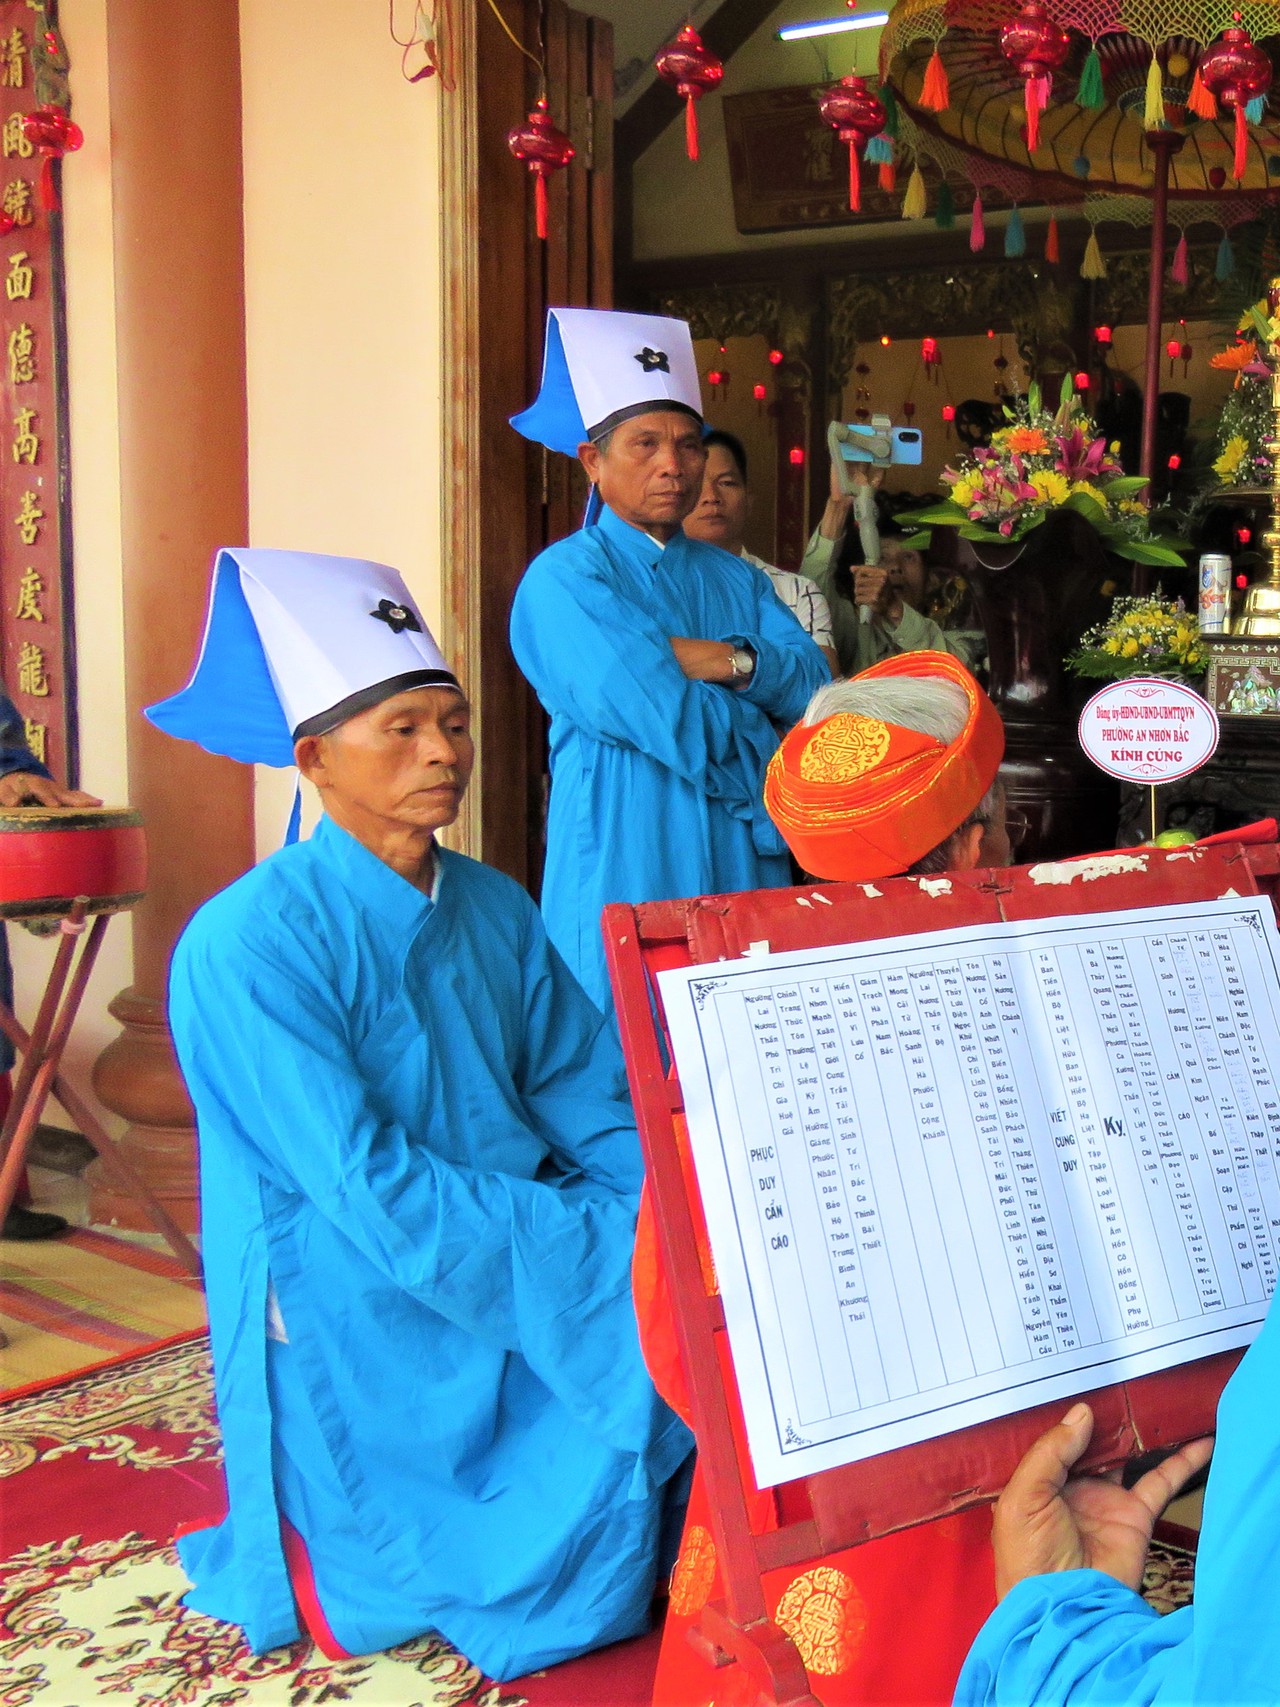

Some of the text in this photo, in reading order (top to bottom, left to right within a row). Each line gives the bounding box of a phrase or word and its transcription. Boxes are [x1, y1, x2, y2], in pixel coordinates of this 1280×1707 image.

[1102, 723, 1189, 742] PHƯỜNG AN NHƠN BẮC
[1111, 747, 1183, 762] KÍNH CÚNG
[1048, 1106, 1078, 1172] VIẾT CUNG DUY
[749, 1145, 774, 1162] PHỤC
[758, 1175, 776, 1191] DUY
